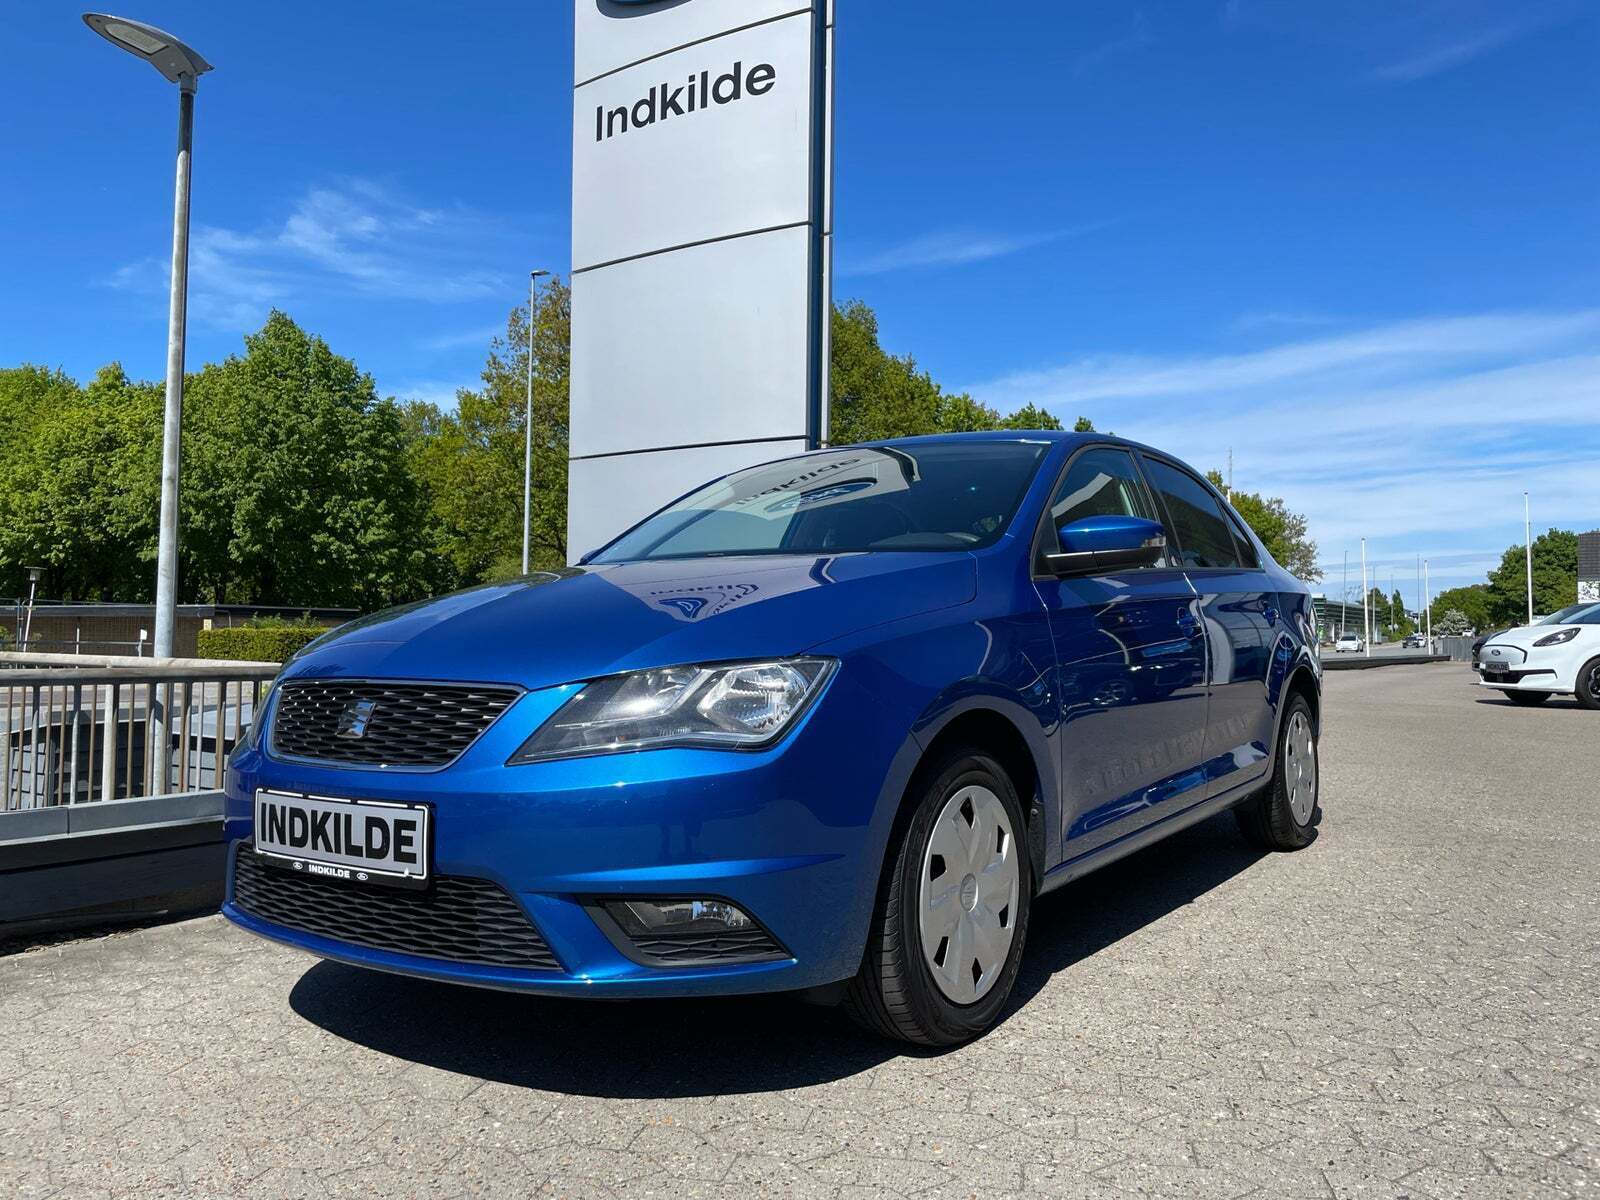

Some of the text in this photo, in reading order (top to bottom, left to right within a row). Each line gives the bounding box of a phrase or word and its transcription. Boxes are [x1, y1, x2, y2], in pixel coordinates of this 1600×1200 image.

[596, 61, 776, 142] Indkilde
[261, 802, 417, 864] INDKILDE
[308, 864, 350, 879] INDKILDE
